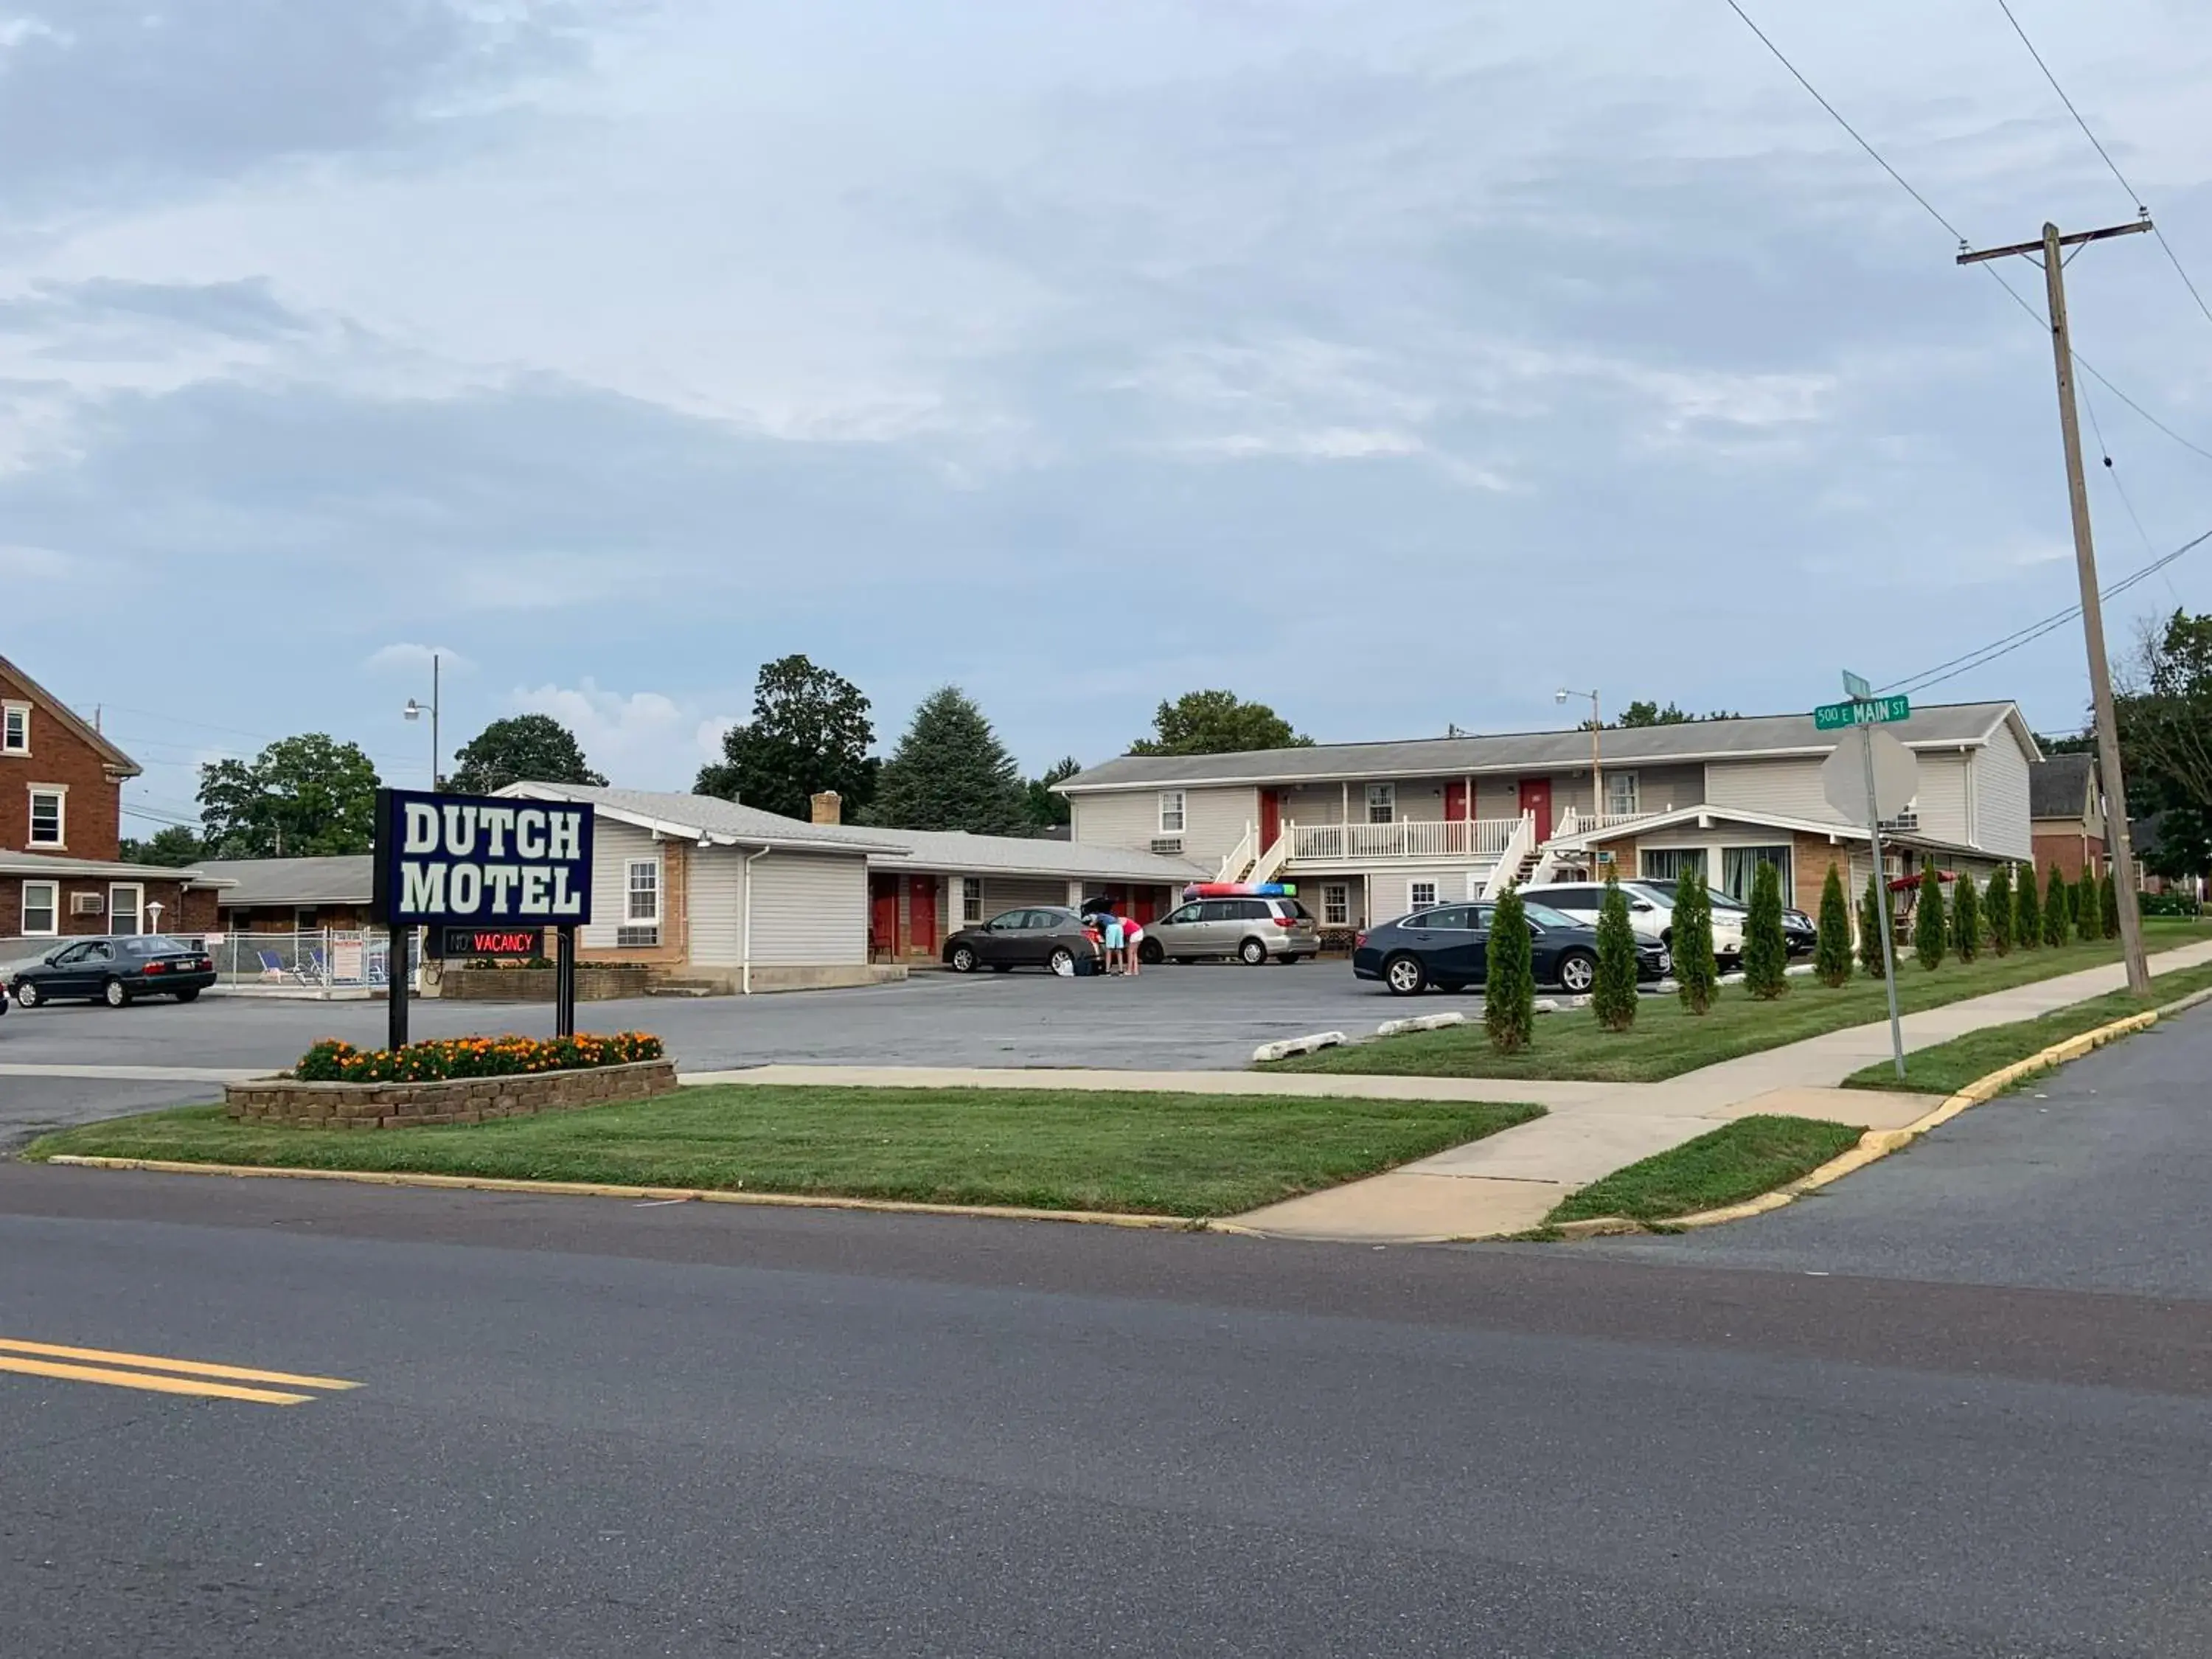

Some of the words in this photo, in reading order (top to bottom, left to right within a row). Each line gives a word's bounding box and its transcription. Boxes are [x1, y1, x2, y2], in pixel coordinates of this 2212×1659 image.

[1818, 708, 1838, 723] 500
[1842, 708, 1849, 722] E
[1853, 700, 1890, 724] MAIN
[1893, 701, 1905, 715] ST
[403, 802, 582, 860] DUTCH
[399, 861, 581, 914] MOTEL
[450, 936, 468, 950] NO
[474, 933, 534, 953] VACANCY
